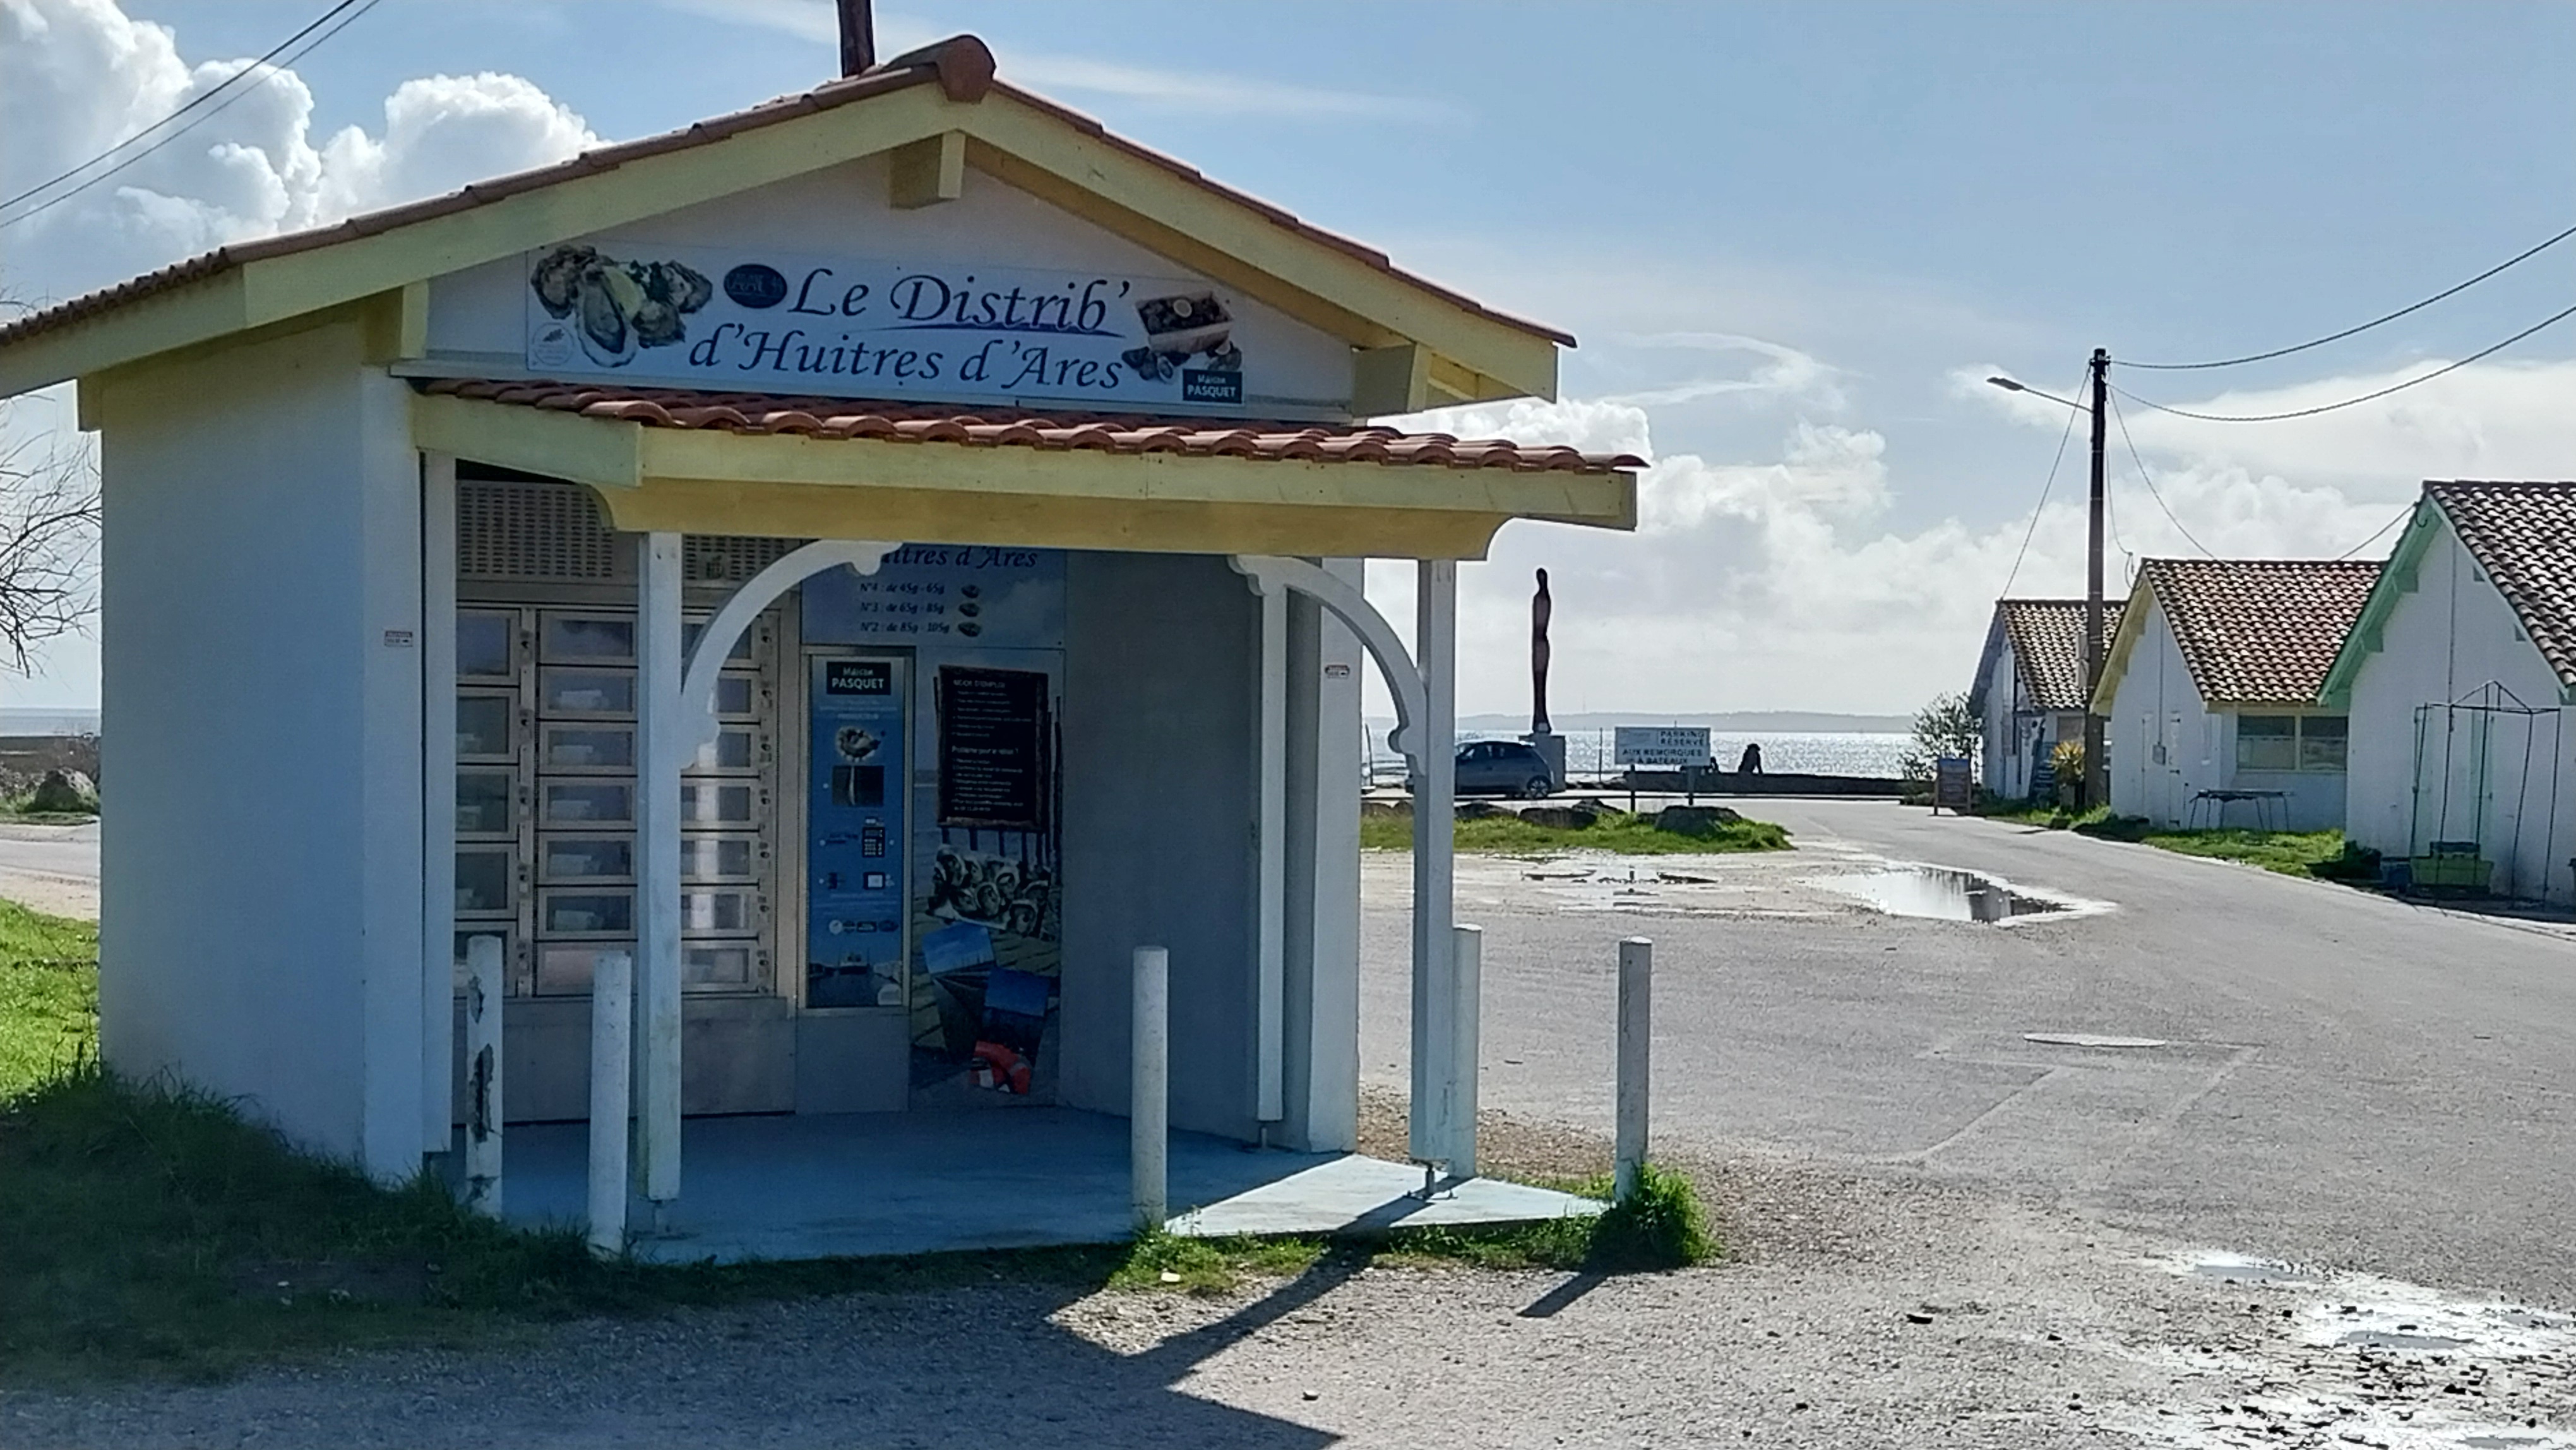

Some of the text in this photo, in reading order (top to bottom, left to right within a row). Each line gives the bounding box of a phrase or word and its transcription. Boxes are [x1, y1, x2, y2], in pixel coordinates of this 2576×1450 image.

[787, 268, 869, 316] Le
[1187, 384, 1236, 398] PASQUET
[832, 678, 884, 690] PASQUET
